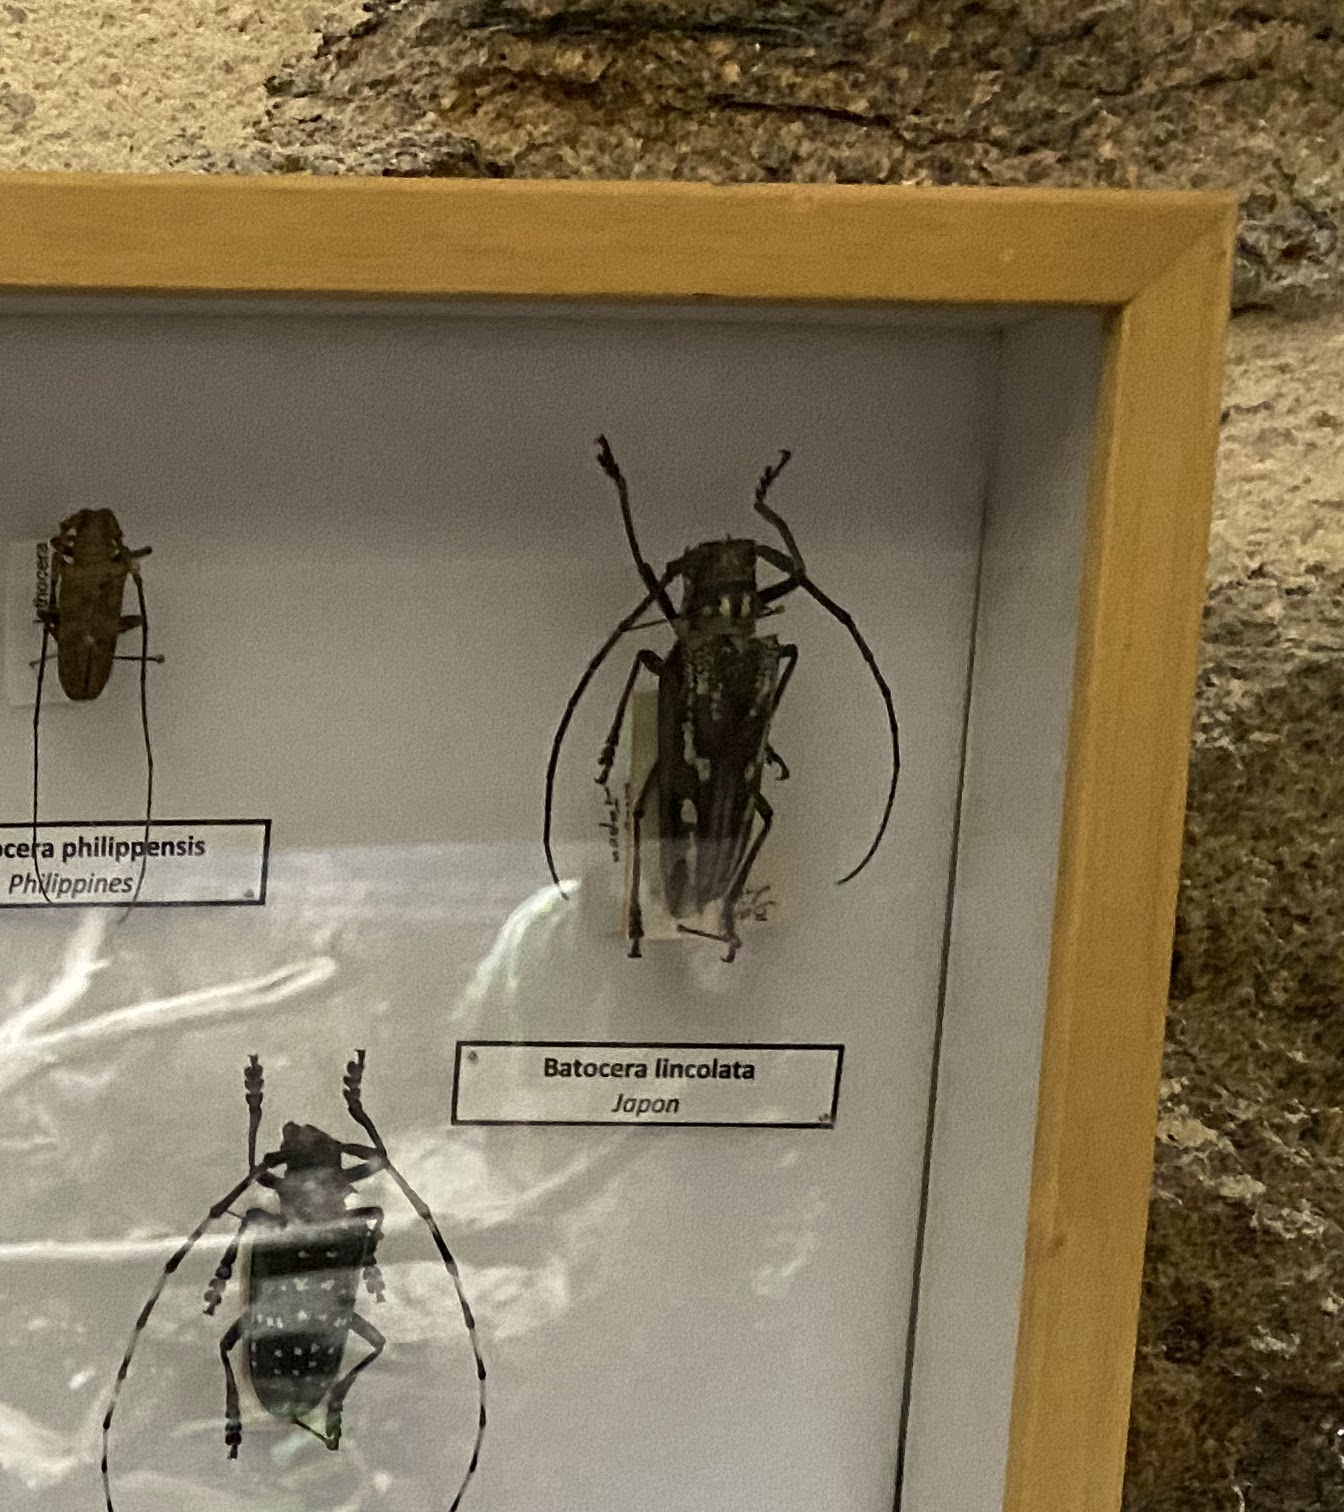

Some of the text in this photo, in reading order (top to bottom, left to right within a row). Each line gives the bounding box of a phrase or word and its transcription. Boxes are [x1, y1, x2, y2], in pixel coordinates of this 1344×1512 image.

[62, 837, 205, 862] philippensis
[8, 874, 133, 897] Philippines
[544, 1058, 756, 1079] Batocera lincolata
[611, 1094, 680, 1115] Japon
